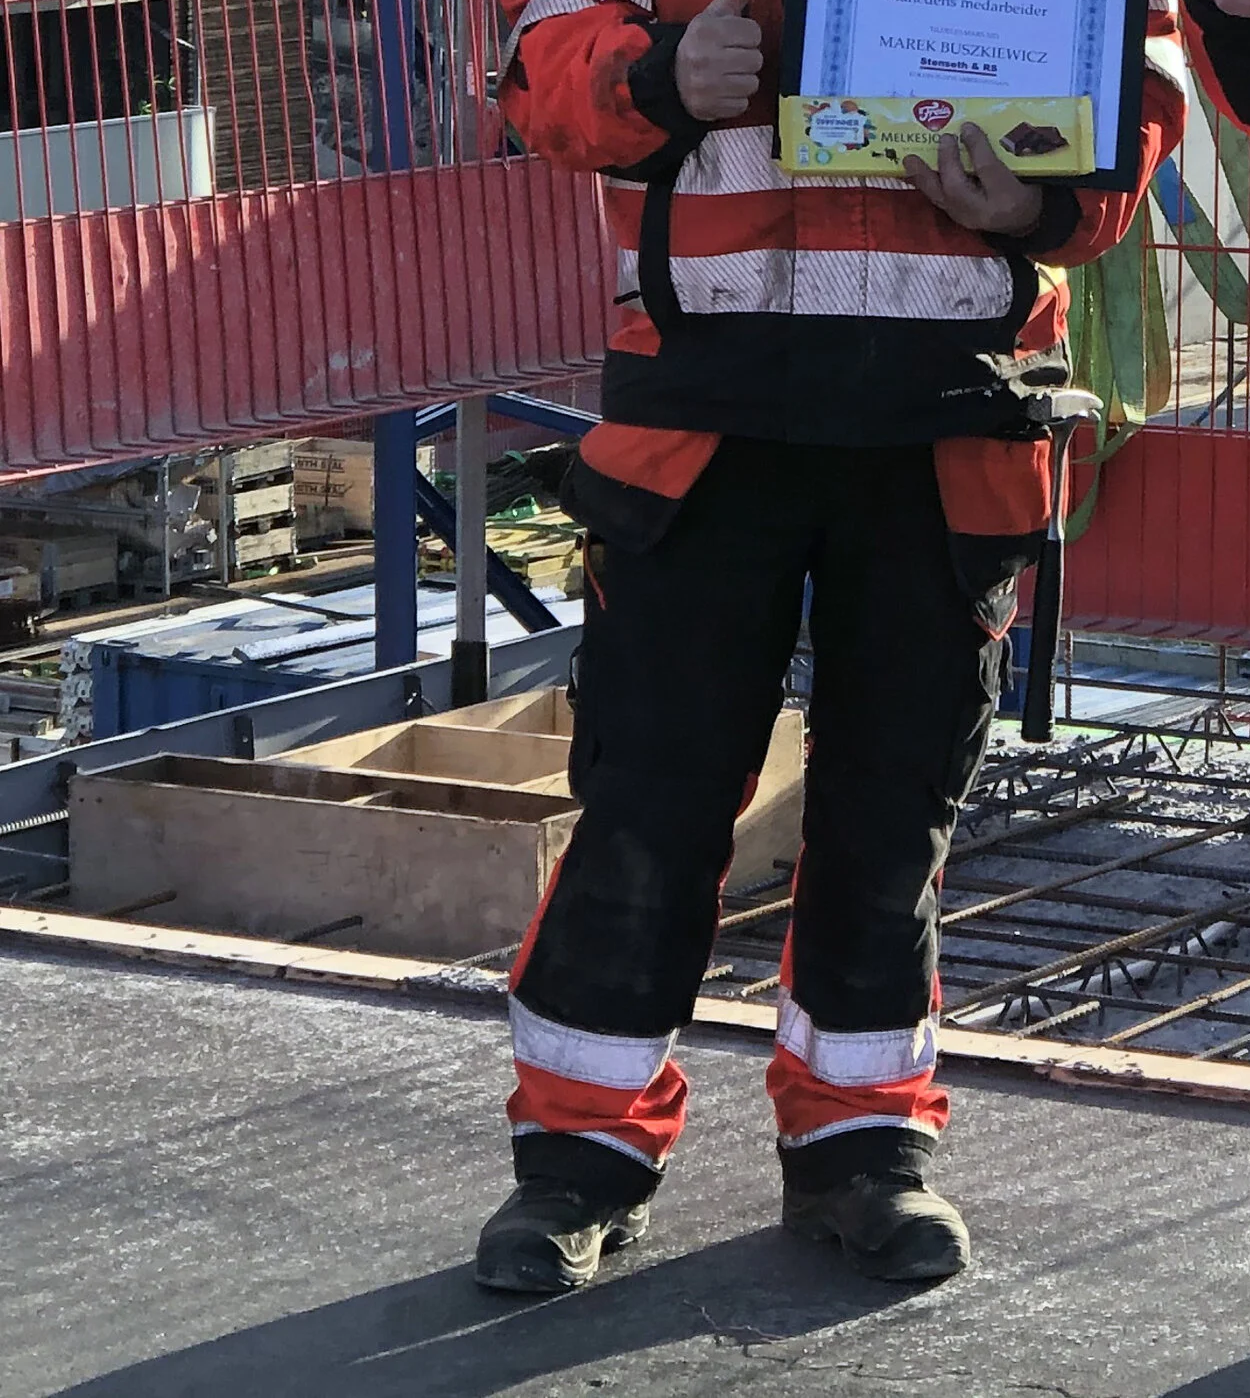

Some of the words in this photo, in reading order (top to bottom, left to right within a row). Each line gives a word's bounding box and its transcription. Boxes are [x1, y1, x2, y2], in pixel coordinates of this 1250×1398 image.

[960, 0, 1049, 18] medarbeider
[879, 35, 937, 53] MAREK
[940, 40, 1049, 64] BUSZKIEWICZ
[919, 56, 968, 70] Stenseth
[971, 61, 980, 71] &
[983, 63, 998, 72] RS
[880, 132, 962, 145] MELKESJO
